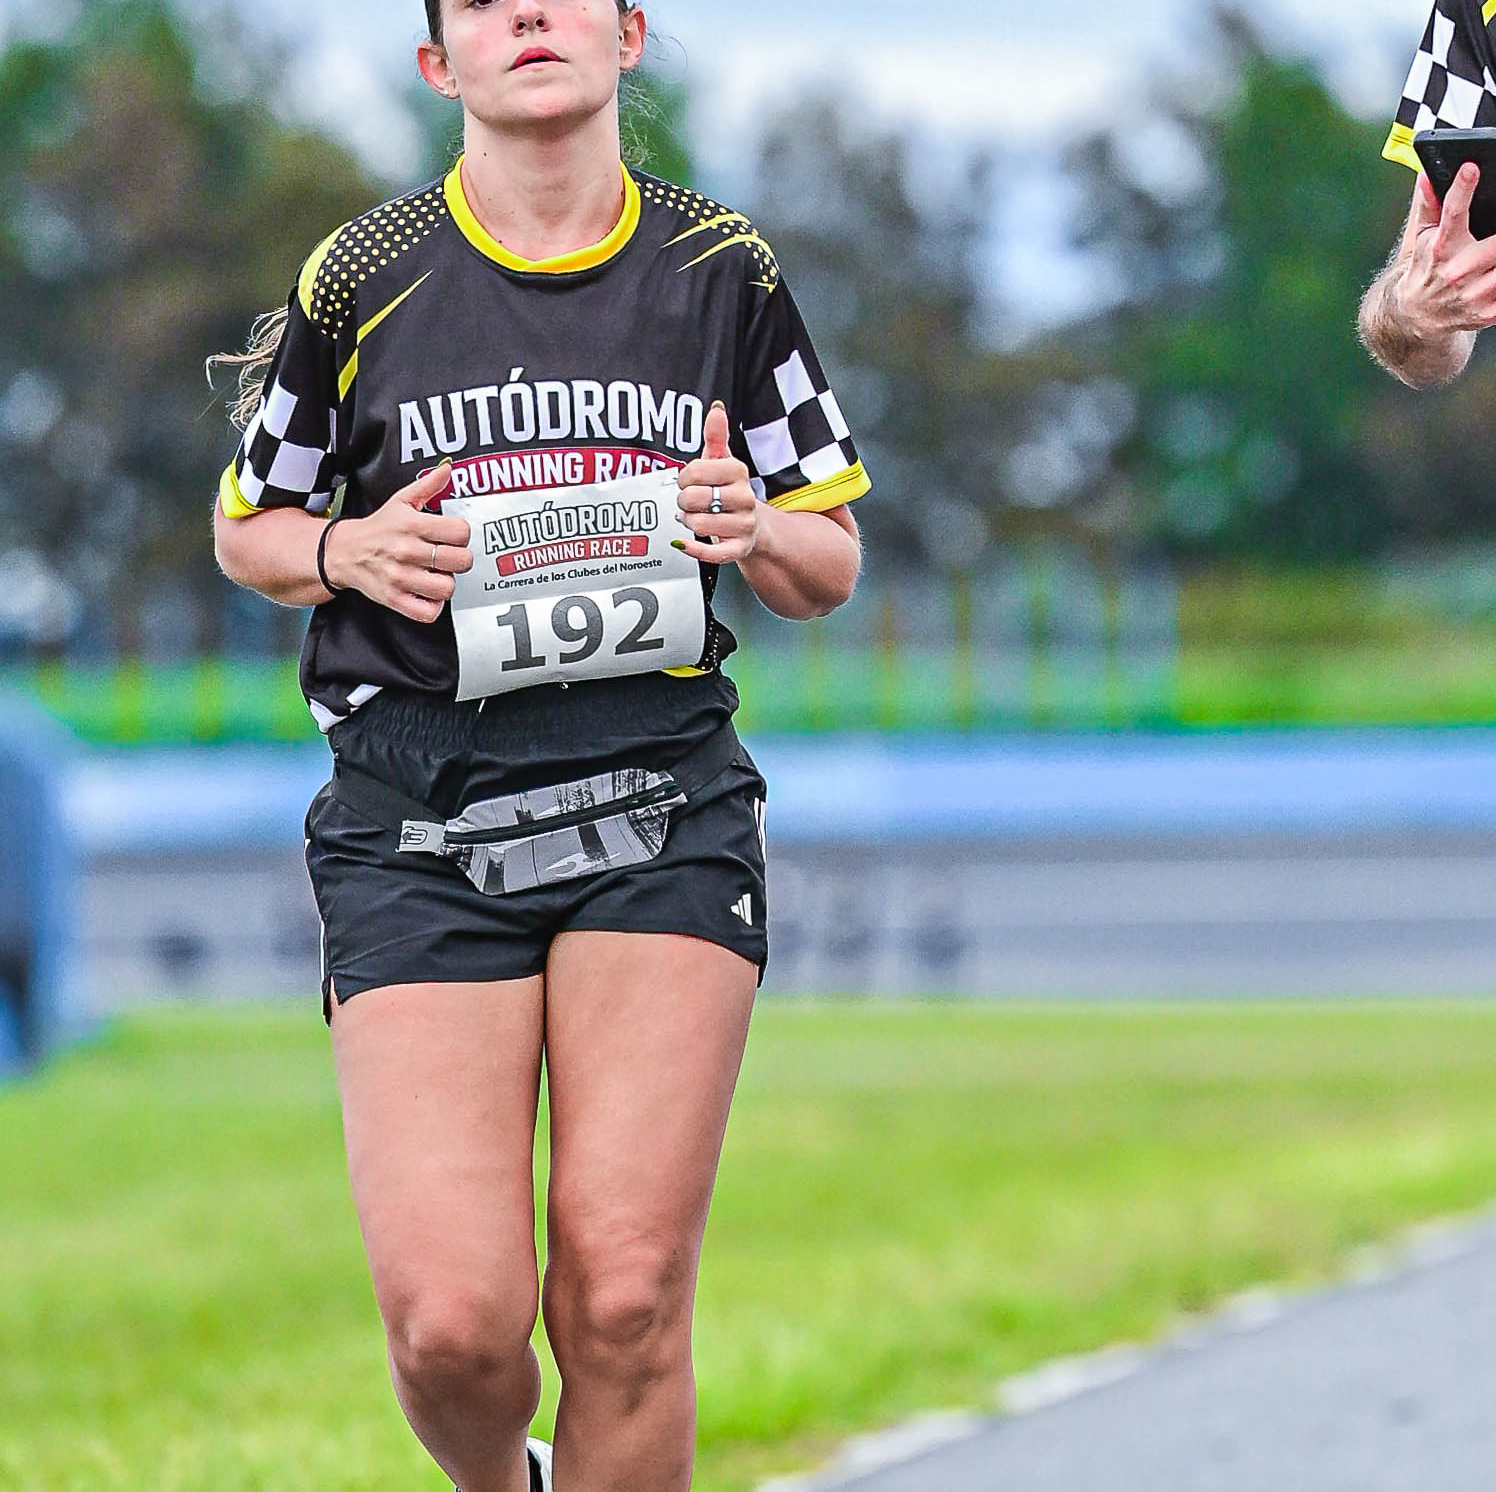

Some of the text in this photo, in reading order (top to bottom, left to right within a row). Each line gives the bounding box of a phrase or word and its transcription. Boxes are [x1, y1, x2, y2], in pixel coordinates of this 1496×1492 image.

[399, 366, 704, 464] AUTÓDROMO
[451, 452, 585, 498] RUNNING
[483, 500, 658, 555] AUTÓDROMO
[484, 559, 663, 591] La Carrera de los Clubes del Noroeste
[513, 538, 631, 571] RUNNING RACE
[496, 586, 665, 672] 192
